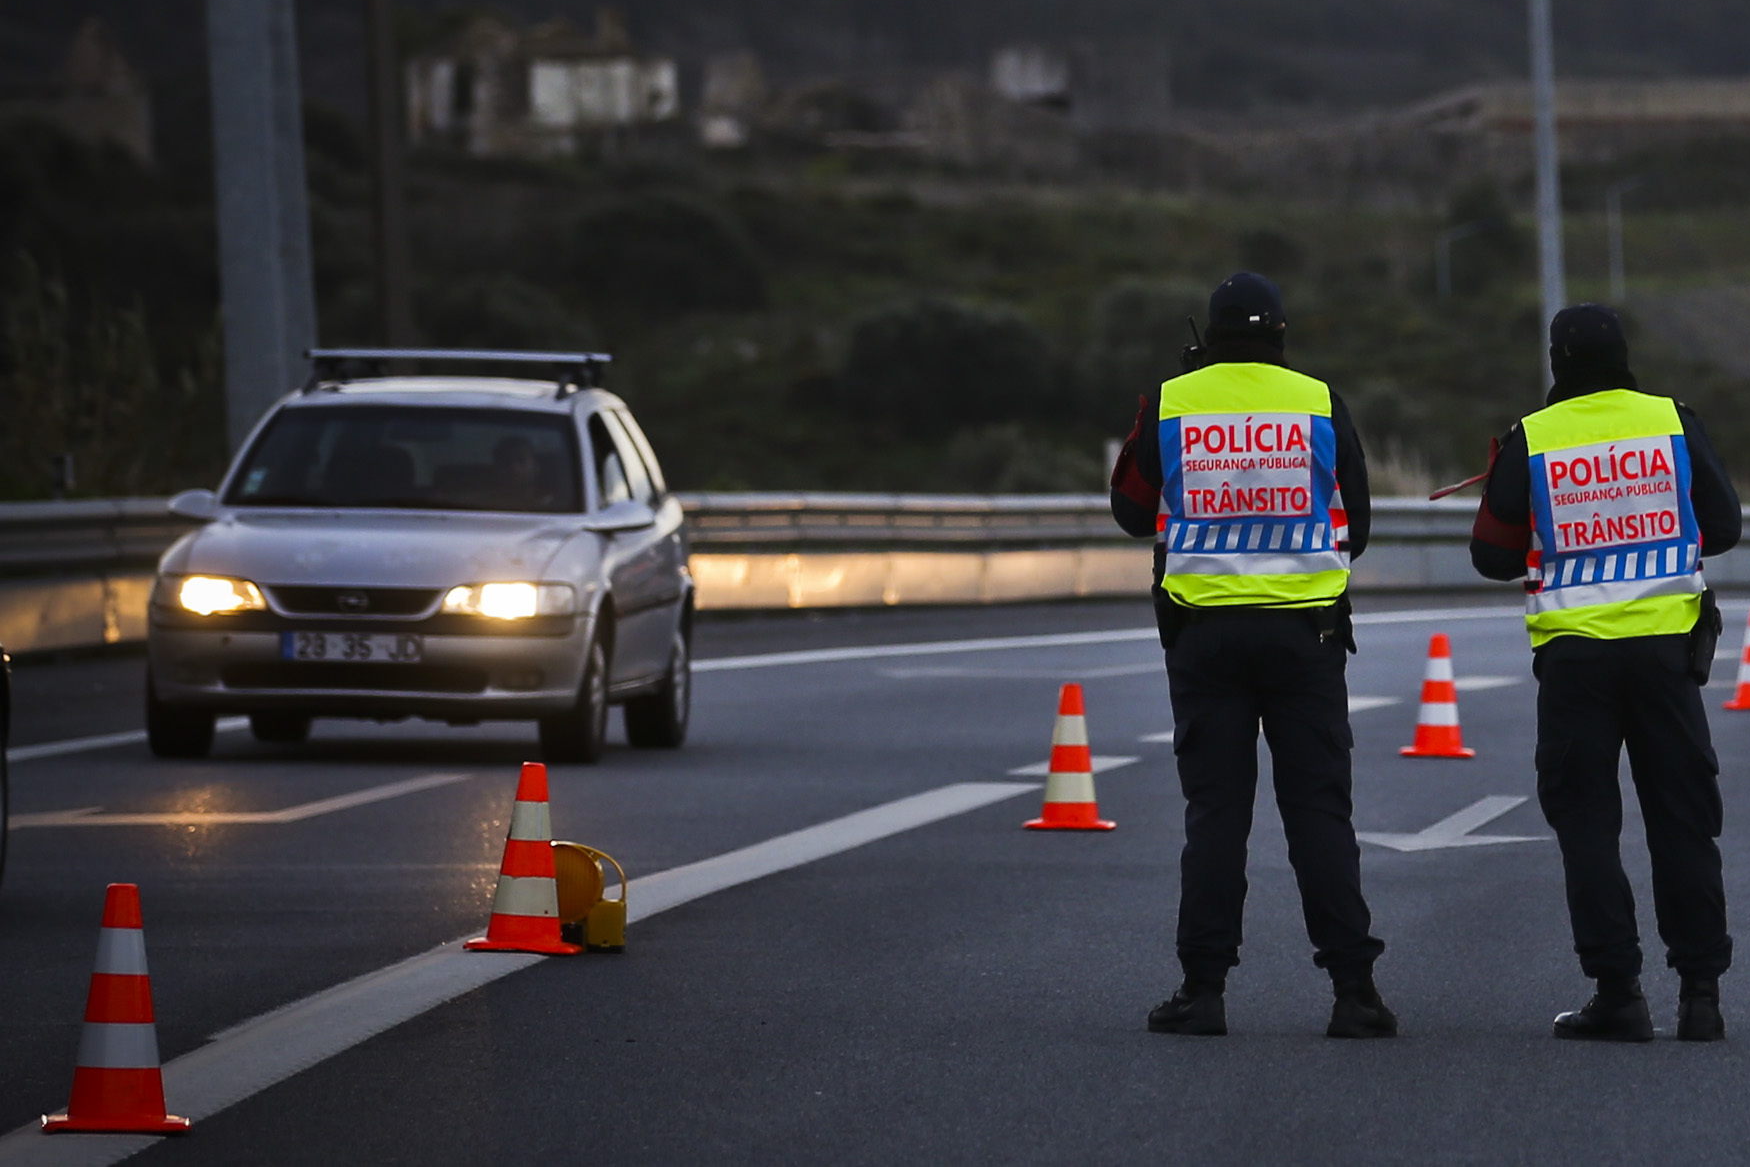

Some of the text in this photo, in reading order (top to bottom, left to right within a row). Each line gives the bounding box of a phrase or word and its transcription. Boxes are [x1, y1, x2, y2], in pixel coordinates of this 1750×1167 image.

[1184, 416, 1307, 454] POLÍCIA
[1186, 454, 1308, 473] SEGURANÇA PÚBLICA
[1550, 445, 1671, 489] POLÍCIA
[1187, 481, 1308, 514] TRÂNSITO
[1554, 481, 1673, 506] SEGURANÇA PÚBLICA
[1558, 510, 1675, 547] TRÂNSITO
